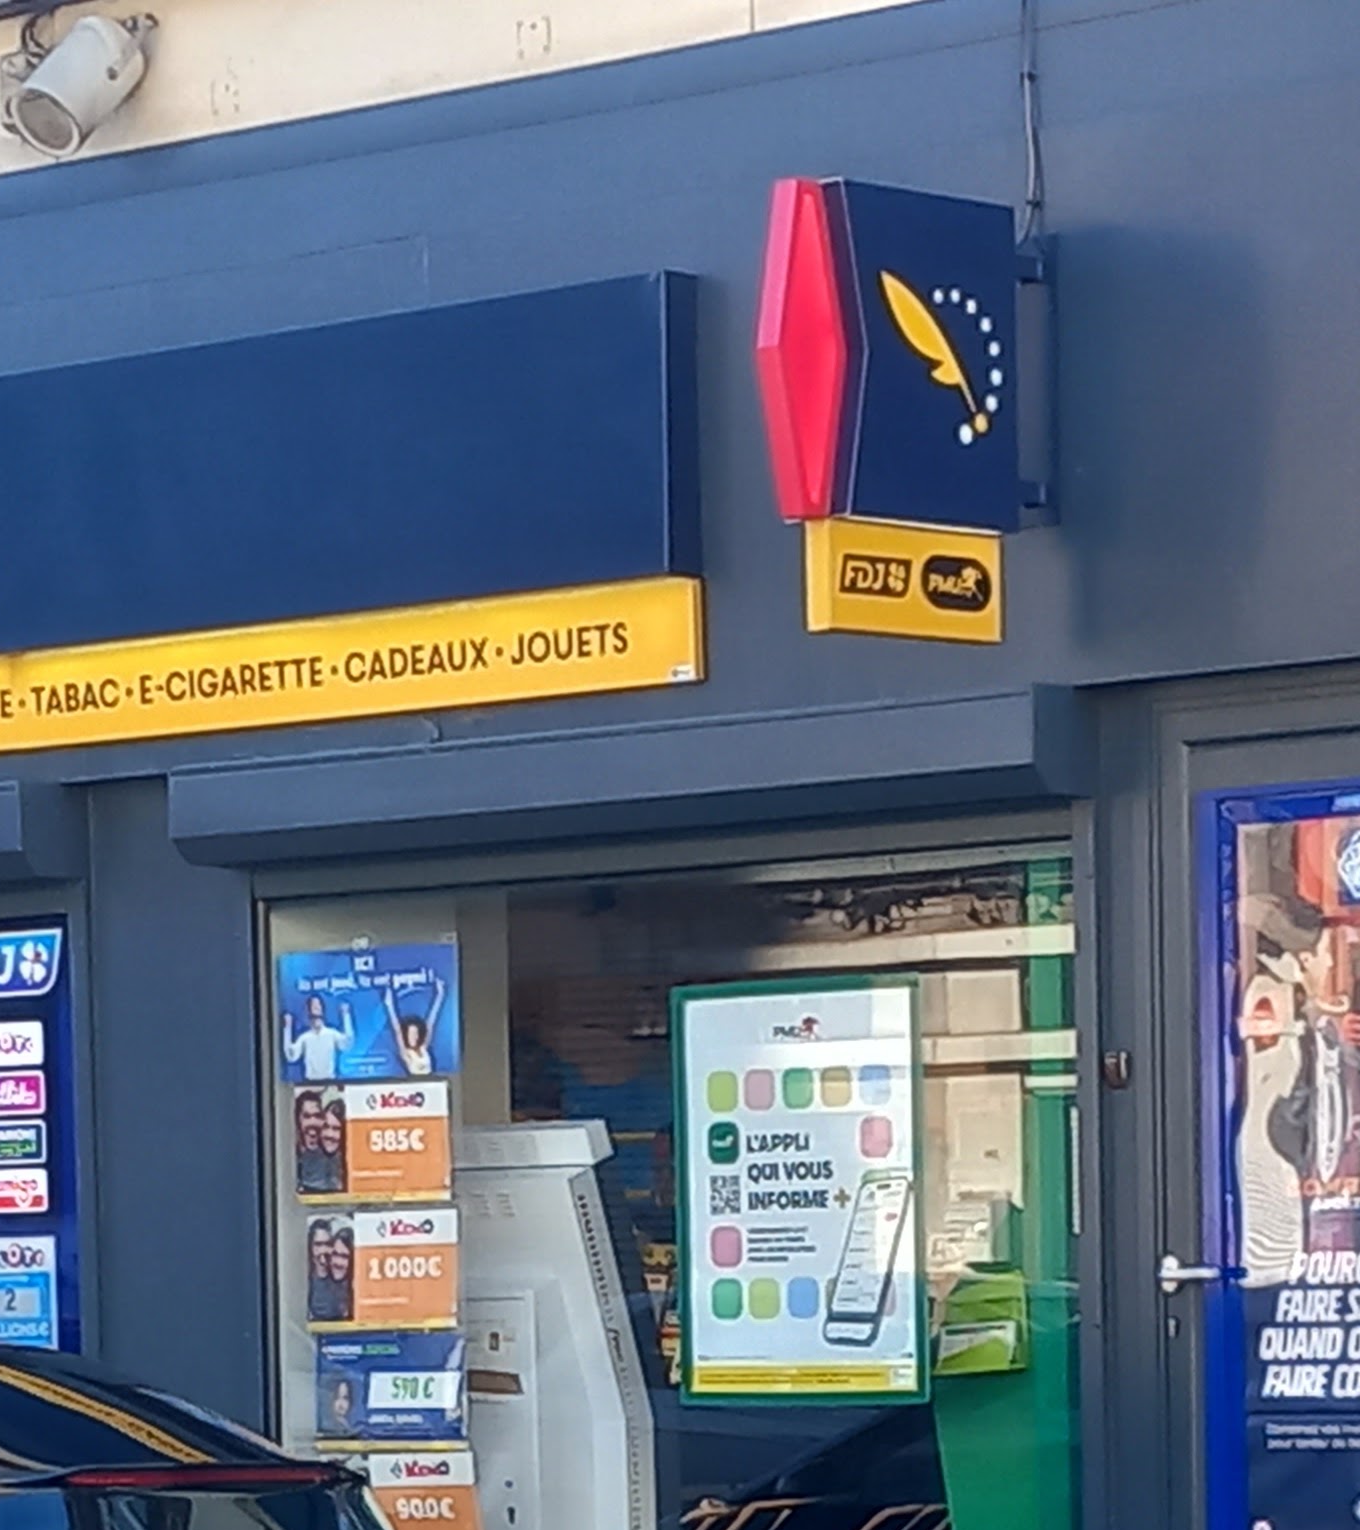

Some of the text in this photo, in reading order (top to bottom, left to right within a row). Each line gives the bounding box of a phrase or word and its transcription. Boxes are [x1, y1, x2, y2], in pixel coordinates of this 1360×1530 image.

[843, 560, 885, 591] FDJ
[30, 678, 120, 717] TABAC
[140, 656, 323, 704] E-CIGARETTE
[344, 637, 489, 682] CADEAUX
[511, 622, 628, 665] JOUETS
[746, 1132, 810, 1154] L'APPLI
[747, 1160, 834, 1184] QUI VOUS
[748, 1189, 829, 1211] INFORME
[5, 1287, 17, 1312] 2
[1276, 1289, 1344, 1323] FAIRE
[1259, 1326, 1344, 1361] QUAND
[1261, 1363, 1331, 1398] FAIRE
